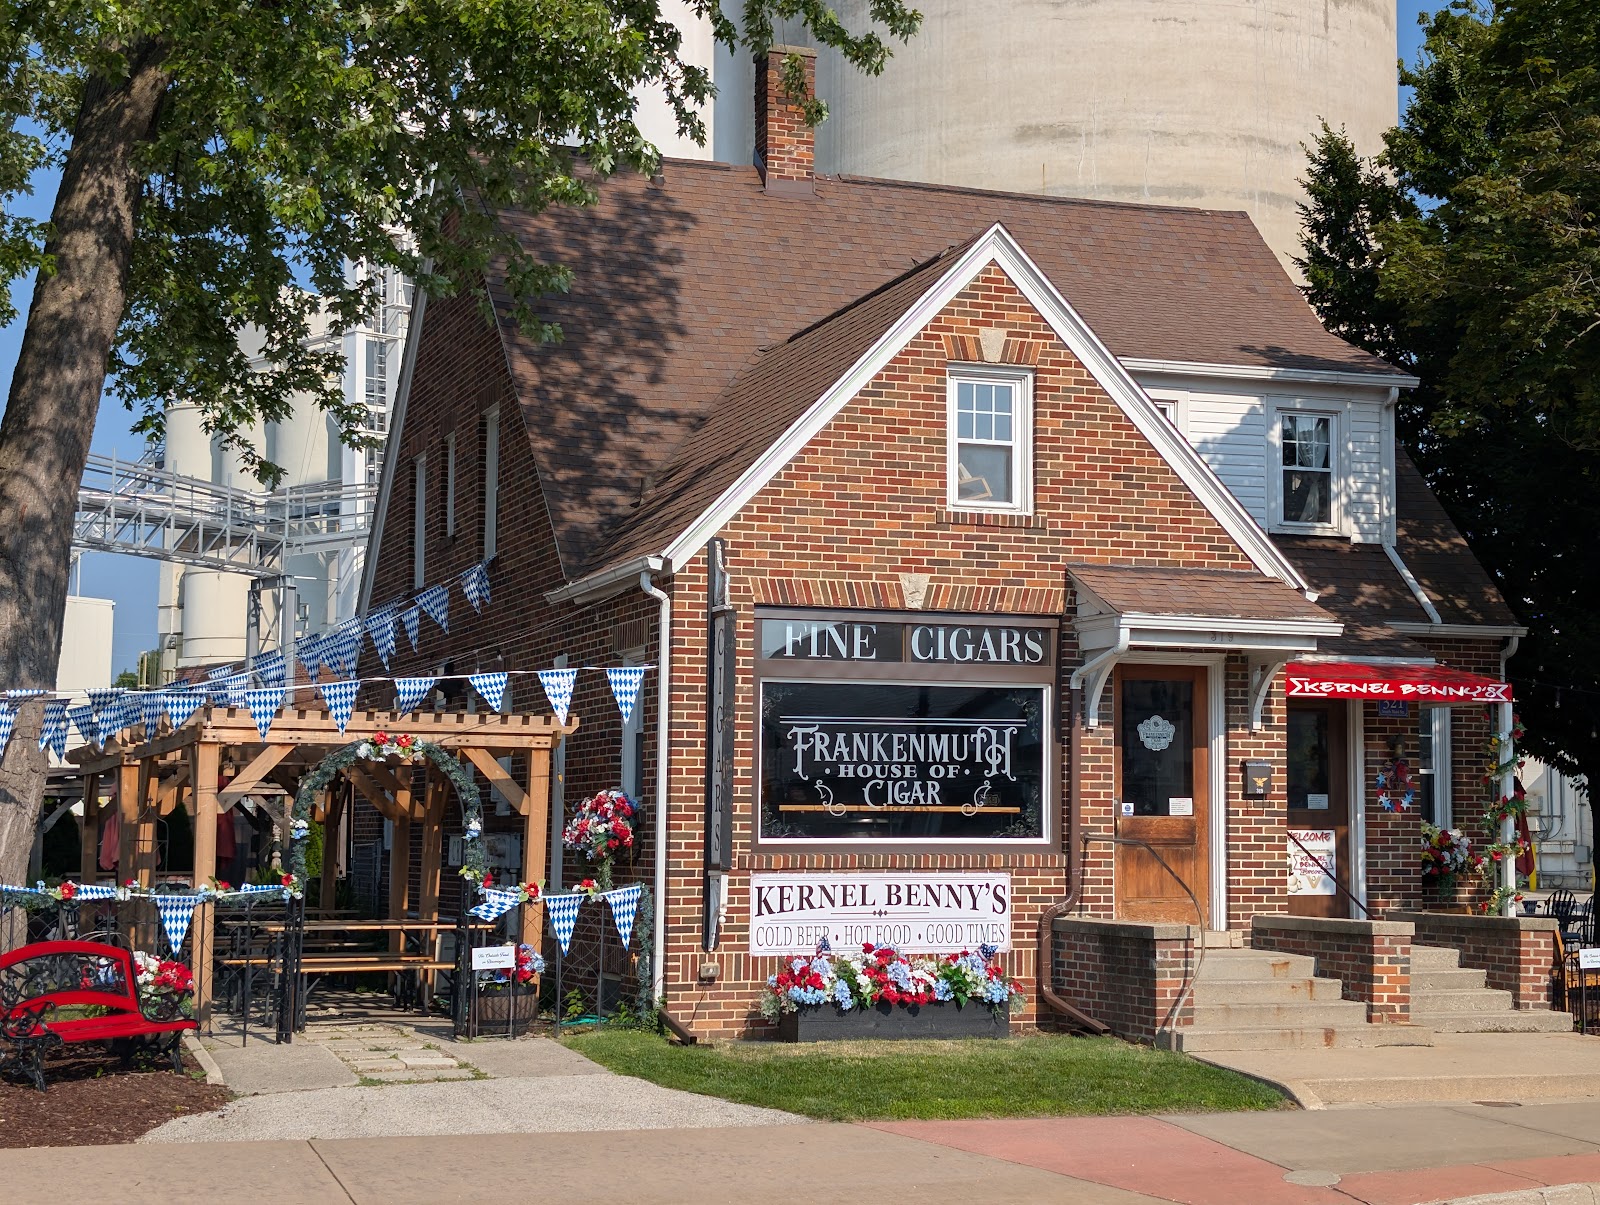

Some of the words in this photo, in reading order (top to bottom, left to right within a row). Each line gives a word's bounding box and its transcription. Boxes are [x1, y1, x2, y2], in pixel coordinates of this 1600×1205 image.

[783, 622, 877, 660] FINE
[910, 625, 1044, 664] CIGARS
[1303, 680, 1395, 695] KERNEL
[1399, 683, 1496, 697] BENNY'S
[714, 626, 725, 853] CIGARS
[786, 724, 1018, 782] FRANKENMUTH
[837, 763, 918, 779] HOUSE
[929, 764, 961, 779] OF
[862, 779, 943, 809] CIGAR
[754, 883, 876, 918] KERNEL
[885, 882, 1008, 915] BENNY'S
[756, 925, 793, 947] COLD
[844, 925, 872, 946] HOT
[875, 924, 911, 945] FOOD
[926, 923, 964, 944] GOOD
[967, 923, 1005, 944] TIMES
